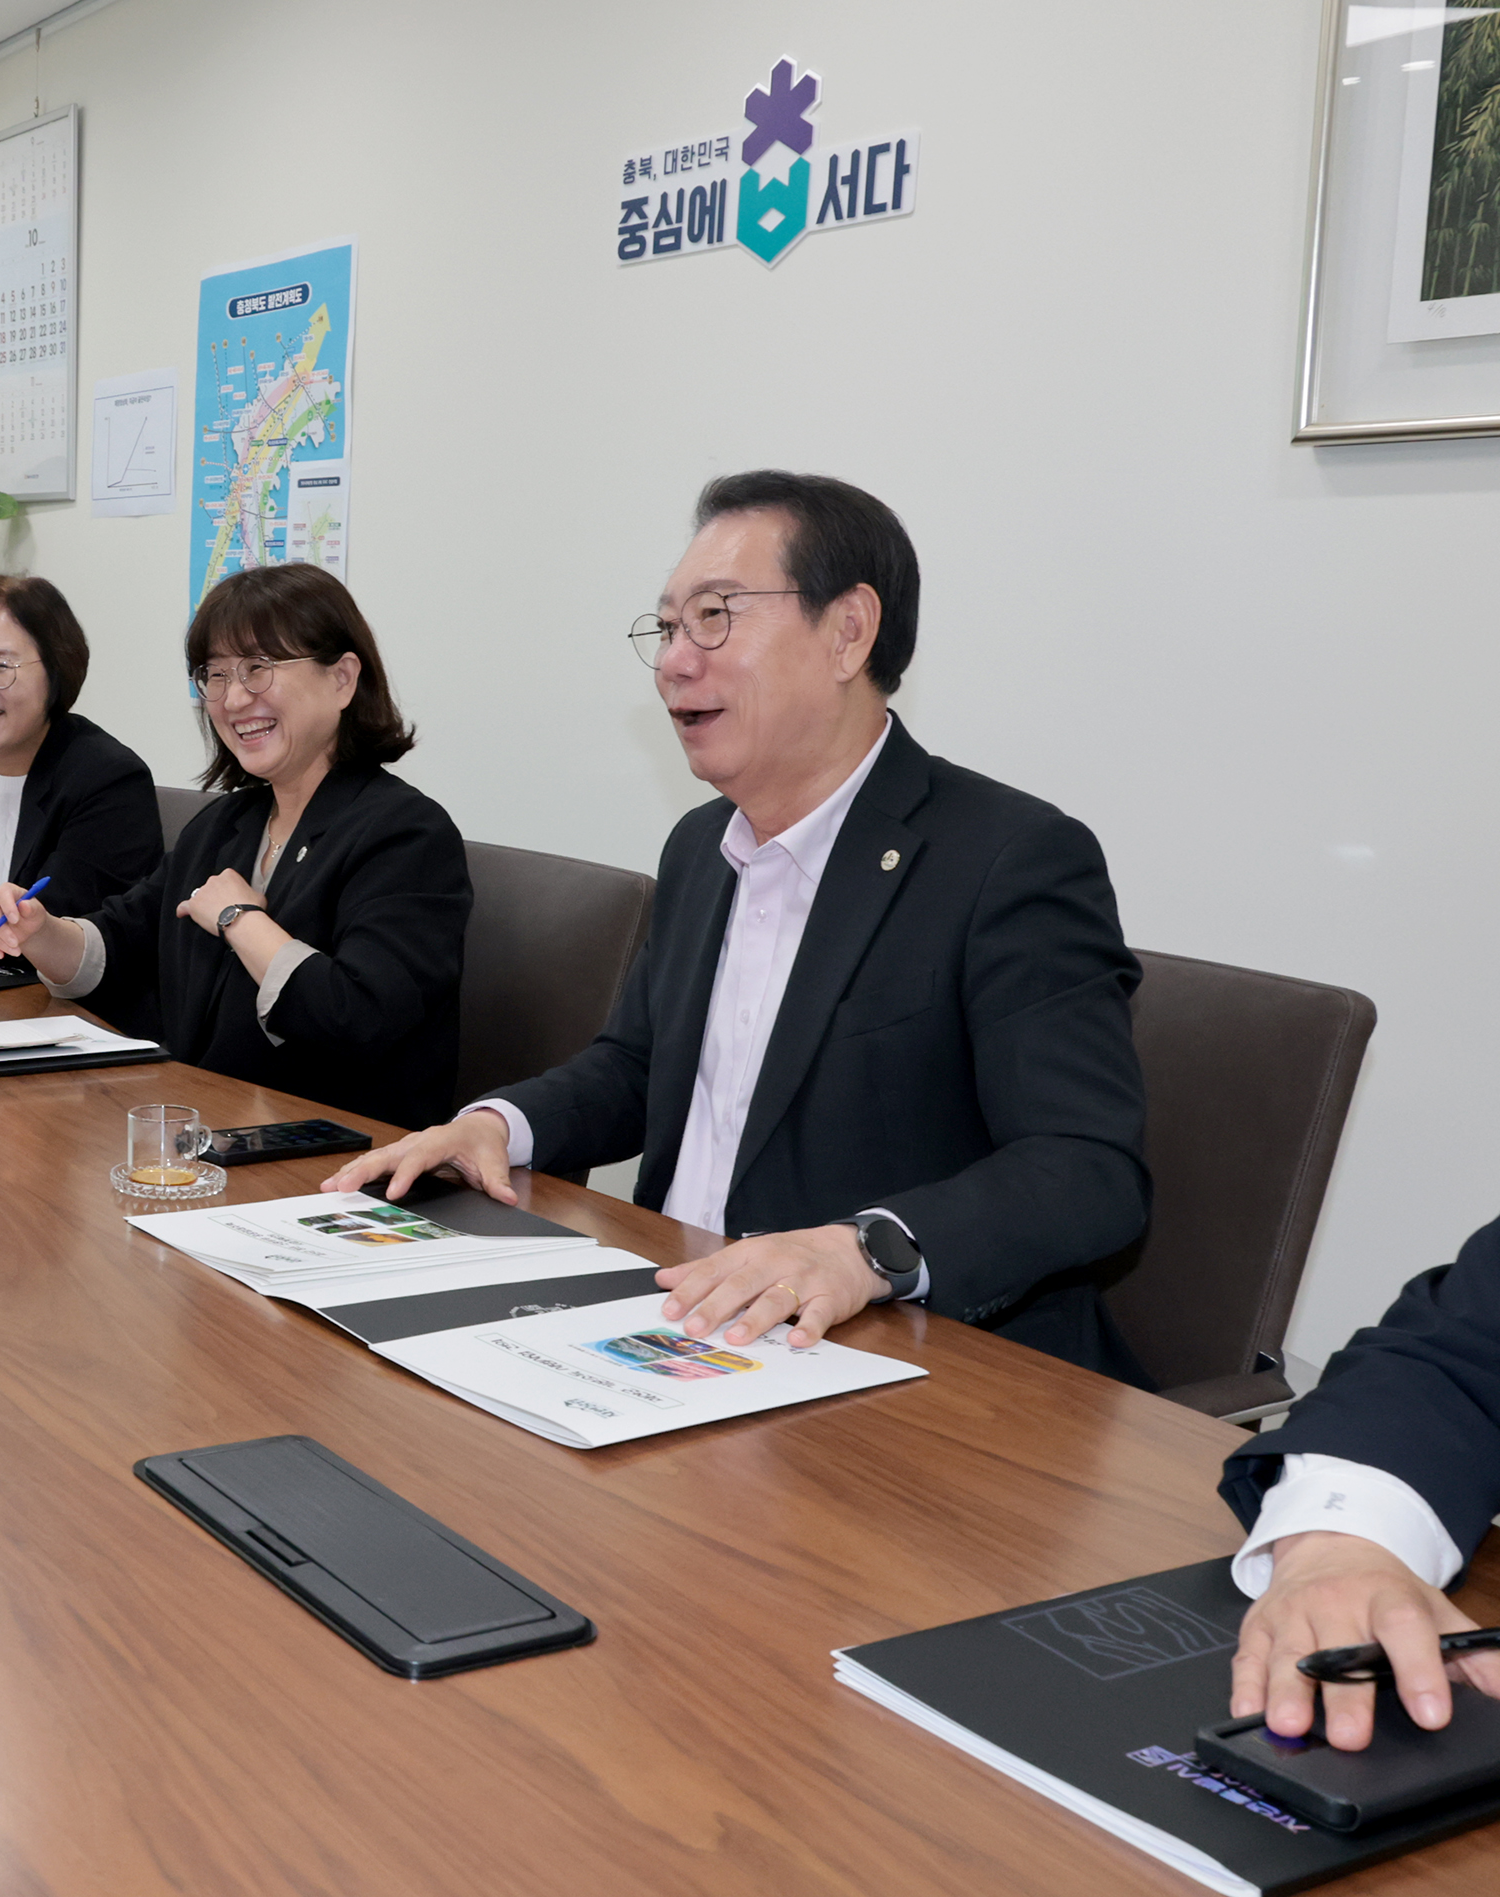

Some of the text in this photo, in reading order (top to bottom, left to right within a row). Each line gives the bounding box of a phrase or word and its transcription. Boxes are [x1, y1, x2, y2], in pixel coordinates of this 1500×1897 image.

[622, 136, 730, 185] 충북, 대한민국
[617, 138, 910, 261] 중심에 서다
[28, 227, 38, 247] 10
[59, 278, 67, 291] 10
[0, 299, 66, 324] 11 12 13 14 15 16 17
[236, 295, 267, 316] 충청북도
[0, 320, 67, 344] 18 19 20 21 22 23 24
[0, 341, 66, 364] 25 26 27 28 29 30 31
